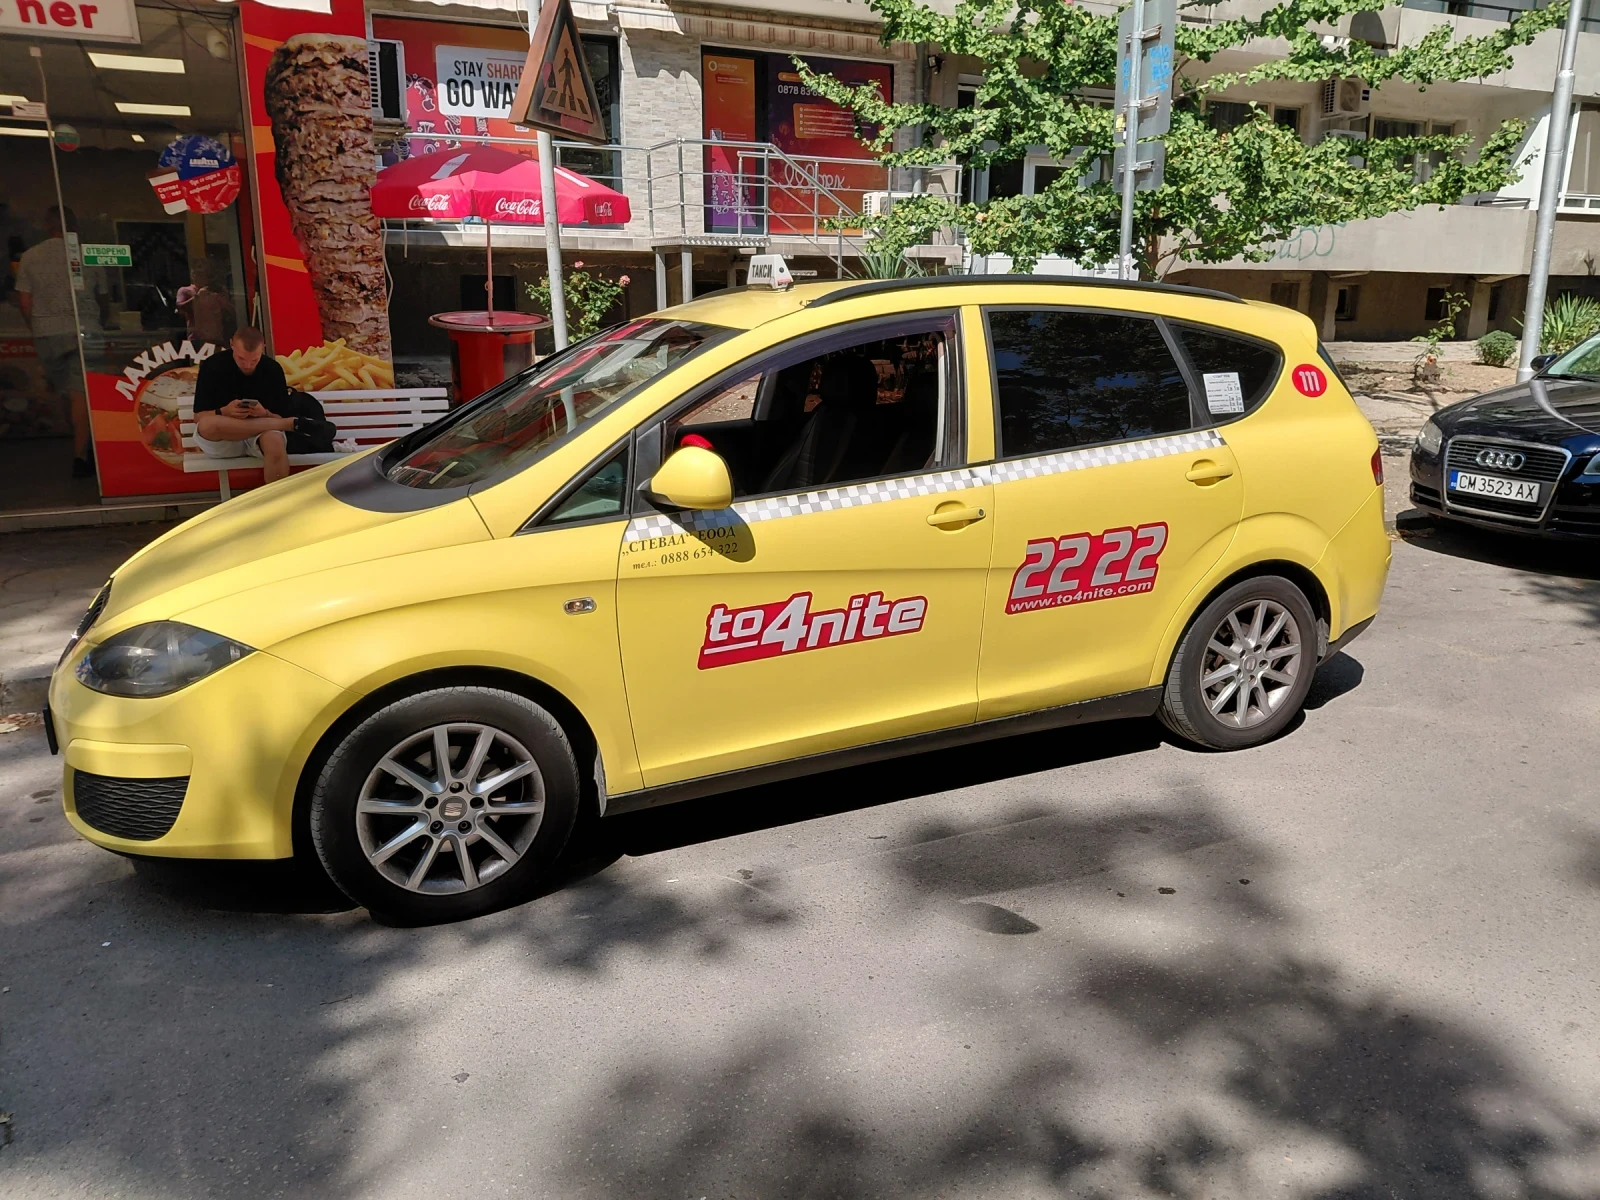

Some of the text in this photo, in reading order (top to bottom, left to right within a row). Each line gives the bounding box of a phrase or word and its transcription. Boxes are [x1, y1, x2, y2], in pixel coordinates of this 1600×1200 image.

[454, 60, 483, 77] STAY
[446, 78, 474, 108] GO
[777, 85, 799, 95] 0878
[408, 194, 451, 211] Coca-Cola
[495, 197, 542, 216] Coca-Cola
[85, 247, 127, 255] ОТВОРЕНО
[97, 256, 118, 265] OPEN
[752, 264, 772, 278] ТАКСИ
[1298, 371, 1320, 392] 111
[1459, 475, 1536, 500] CM 3523 AX
[698, 525, 736, 541] ЕООД
[660, 550, 689, 565] 0888
[693, 546, 714, 560] 654
[719, 542, 739, 555] 322
[1010, 581, 1152, 613] www.to4nite.com
[708, 594, 926, 652] to4nite
